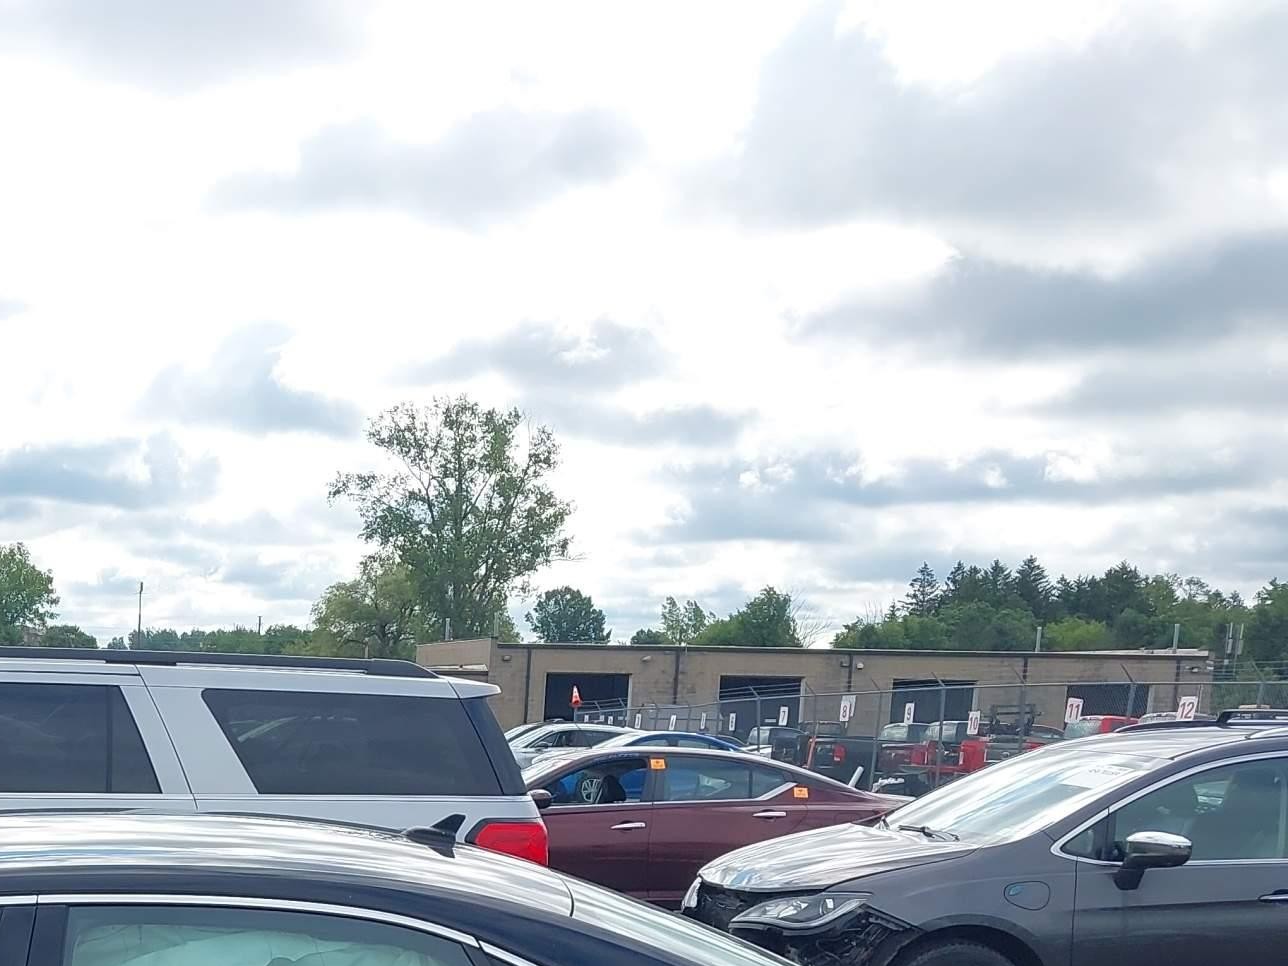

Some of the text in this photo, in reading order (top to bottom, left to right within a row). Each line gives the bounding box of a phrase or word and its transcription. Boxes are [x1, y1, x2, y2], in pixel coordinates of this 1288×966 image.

[842, 705, 848, 719] 8
[907, 707, 912, 721] 9
[1068, 703, 1081, 720] 11
[1178, 702, 1195, 719] 12
[969, 716, 979, 731] 10
